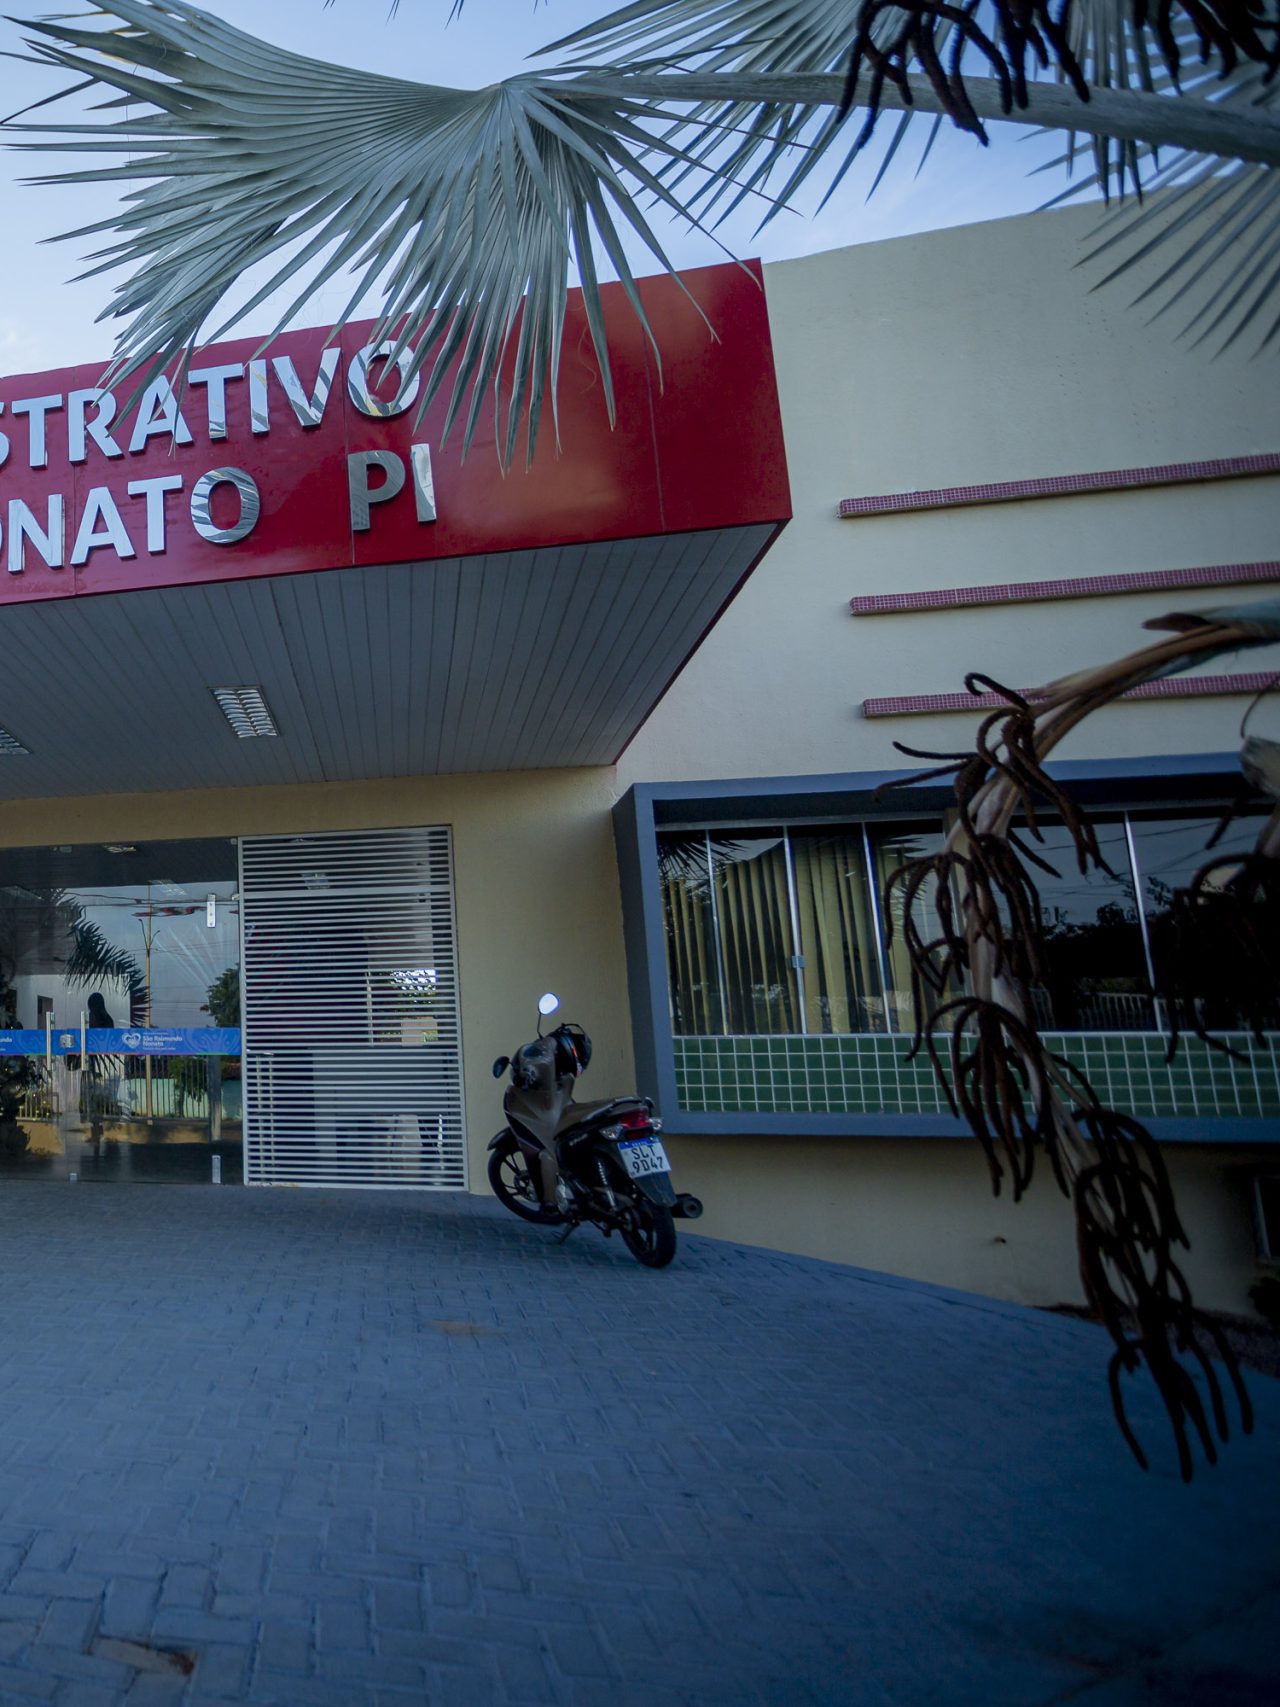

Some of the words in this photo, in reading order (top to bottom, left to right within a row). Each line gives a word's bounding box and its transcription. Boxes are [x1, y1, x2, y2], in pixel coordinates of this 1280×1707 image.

[347, 443, 438, 531] PI
[631, 1145, 656, 1160] SLT
[632, 1156, 663, 1174] 9D47
